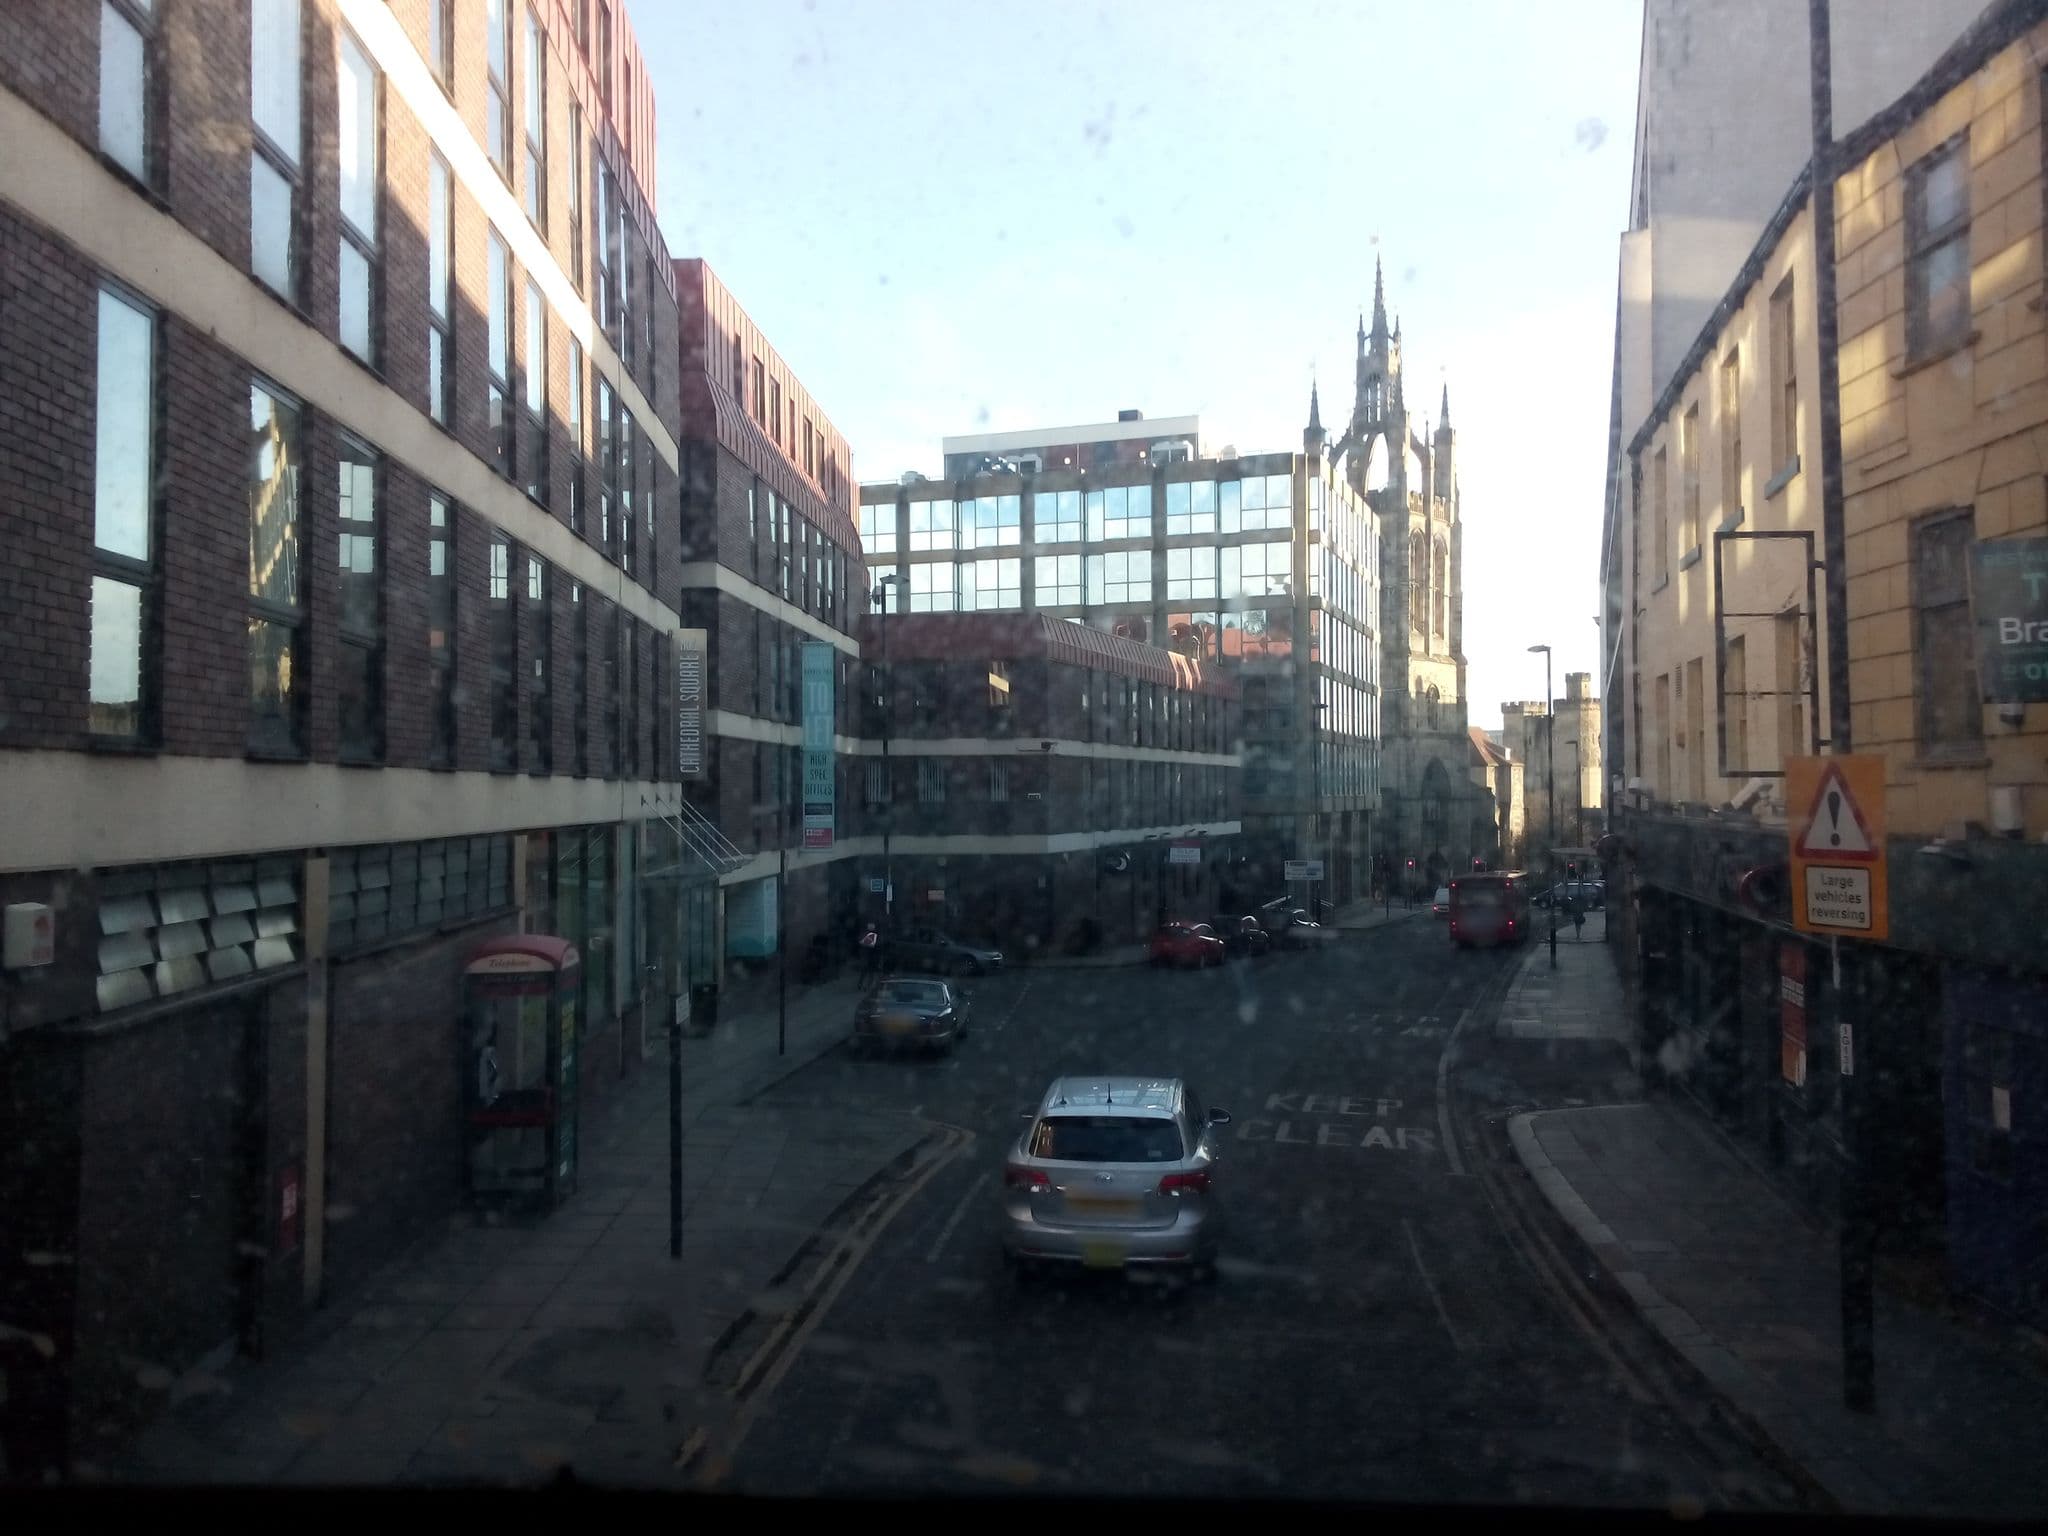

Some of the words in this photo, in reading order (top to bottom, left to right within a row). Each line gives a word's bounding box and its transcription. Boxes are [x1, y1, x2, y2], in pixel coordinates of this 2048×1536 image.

[680, 654, 702, 702] SQUARE
[808, 682, 828, 713] TO
[680, 704, 701, 774] CATHEDRAL
[1821, 872, 1854, 889] Large
[1814, 889, 1862, 905] vehicles
[1811, 907, 1866, 924] reversing
[1264, 1092, 1405, 1118] KEEP
[1235, 1119, 1438, 1151] CLEAR
